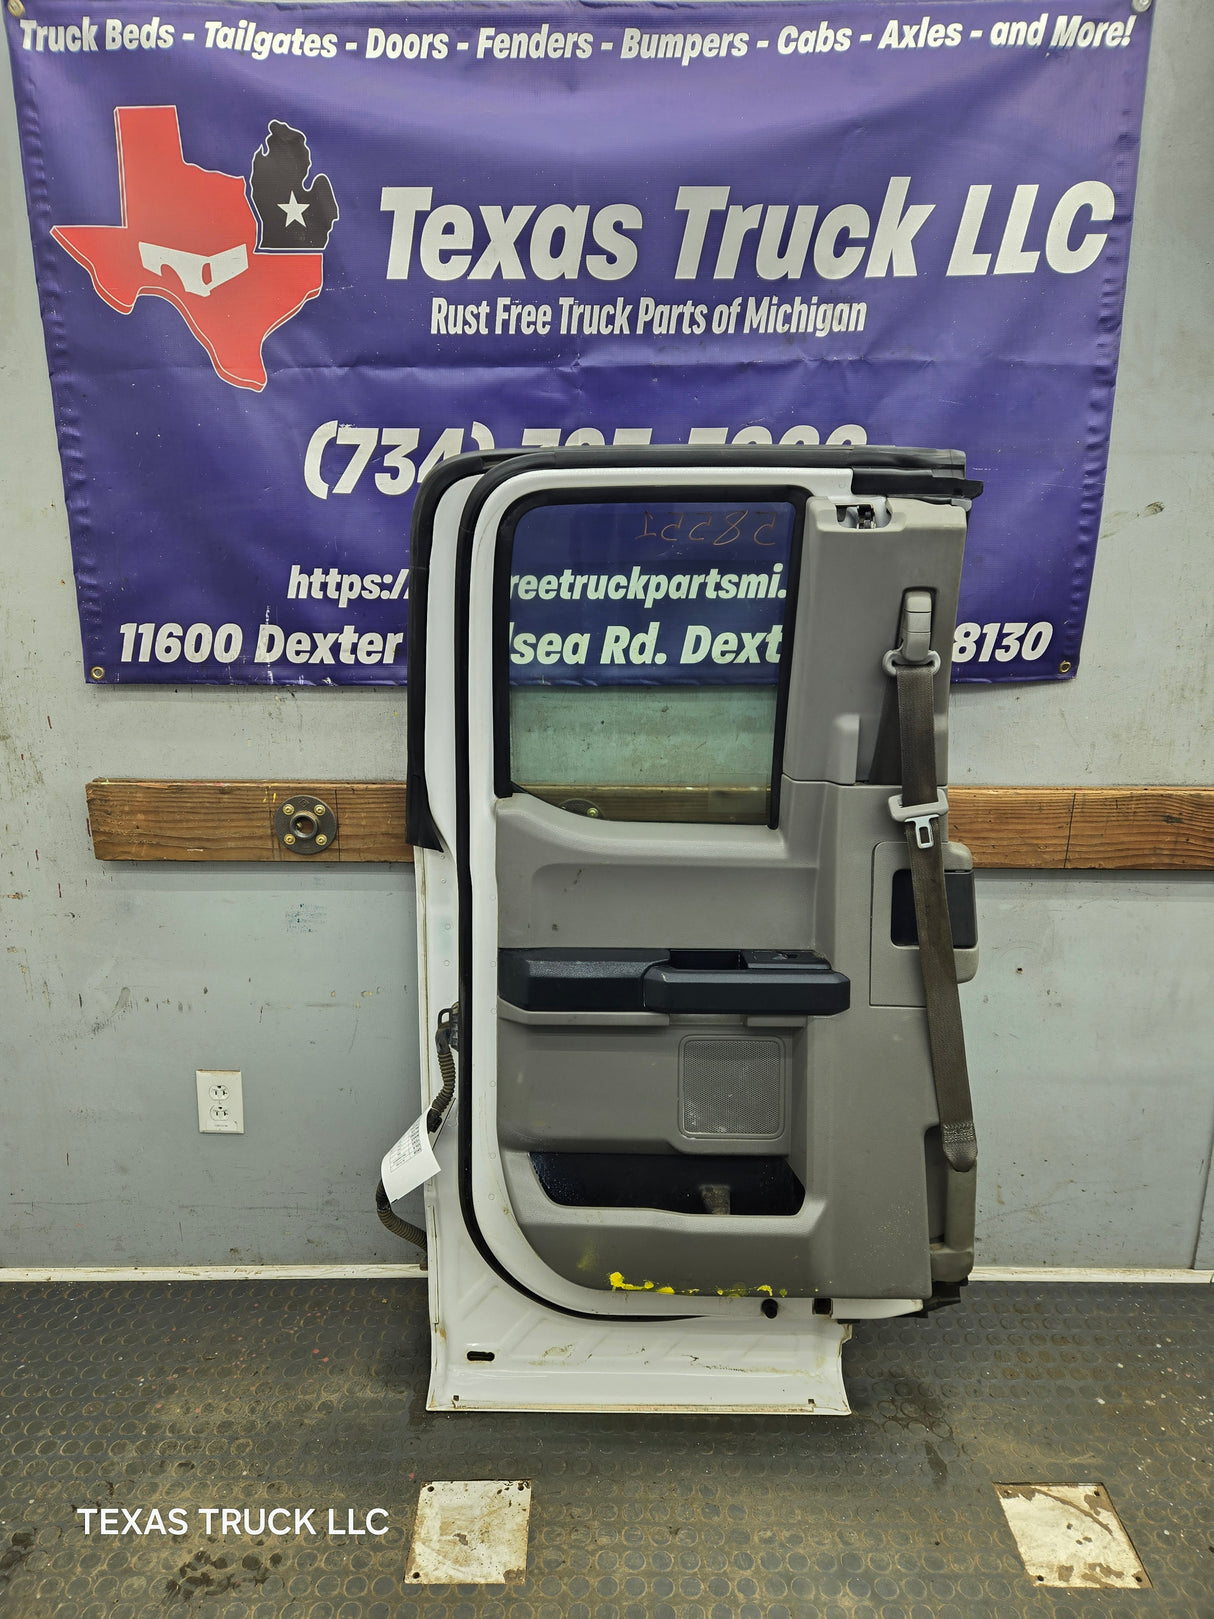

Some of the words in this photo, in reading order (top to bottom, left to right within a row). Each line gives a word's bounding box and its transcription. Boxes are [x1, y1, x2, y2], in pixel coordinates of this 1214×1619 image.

[19, 17, 99, 52] Truck
[105, 17, 175, 50] Beds
[181, 32, 196, 42] -
[204, 20, 338, 60] Tailgates
[345, 42, 358, 51] -
[365, 28, 449, 60] Doors
[456, 42, 469, 51] -
[476, 24, 594, 59] Fenders
[600, 42, 614, 51] -
[620, 27, 750, 66] Bumpers
[756, 40, 770, 49] -
[777, 22, 853, 55] Cabs
[859, 33, 873, 43] -
[877, 16, 963, 50] Axles
[969, 29, 984, 39] -
[989, 13, 1046, 47] and
[1049, 15, 1137, 48] More!
[379, 186, 643, 281] Texas
[674, 176, 936, 280] Truck
[945, 180, 1115, 277] LLC
[430, 297, 490, 335] Rust
[494, 297, 552, 335] Free
[558, 297, 633, 335] Truck
[636, 297, 708, 335] Parts
[712, 296, 743, 335] of
[743, 295, 867, 338] Michigan
[119, 622, 243, 663] 11600
[254, 624, 404, 665] Dexter
[600, 621, 667, 665] Rd.
